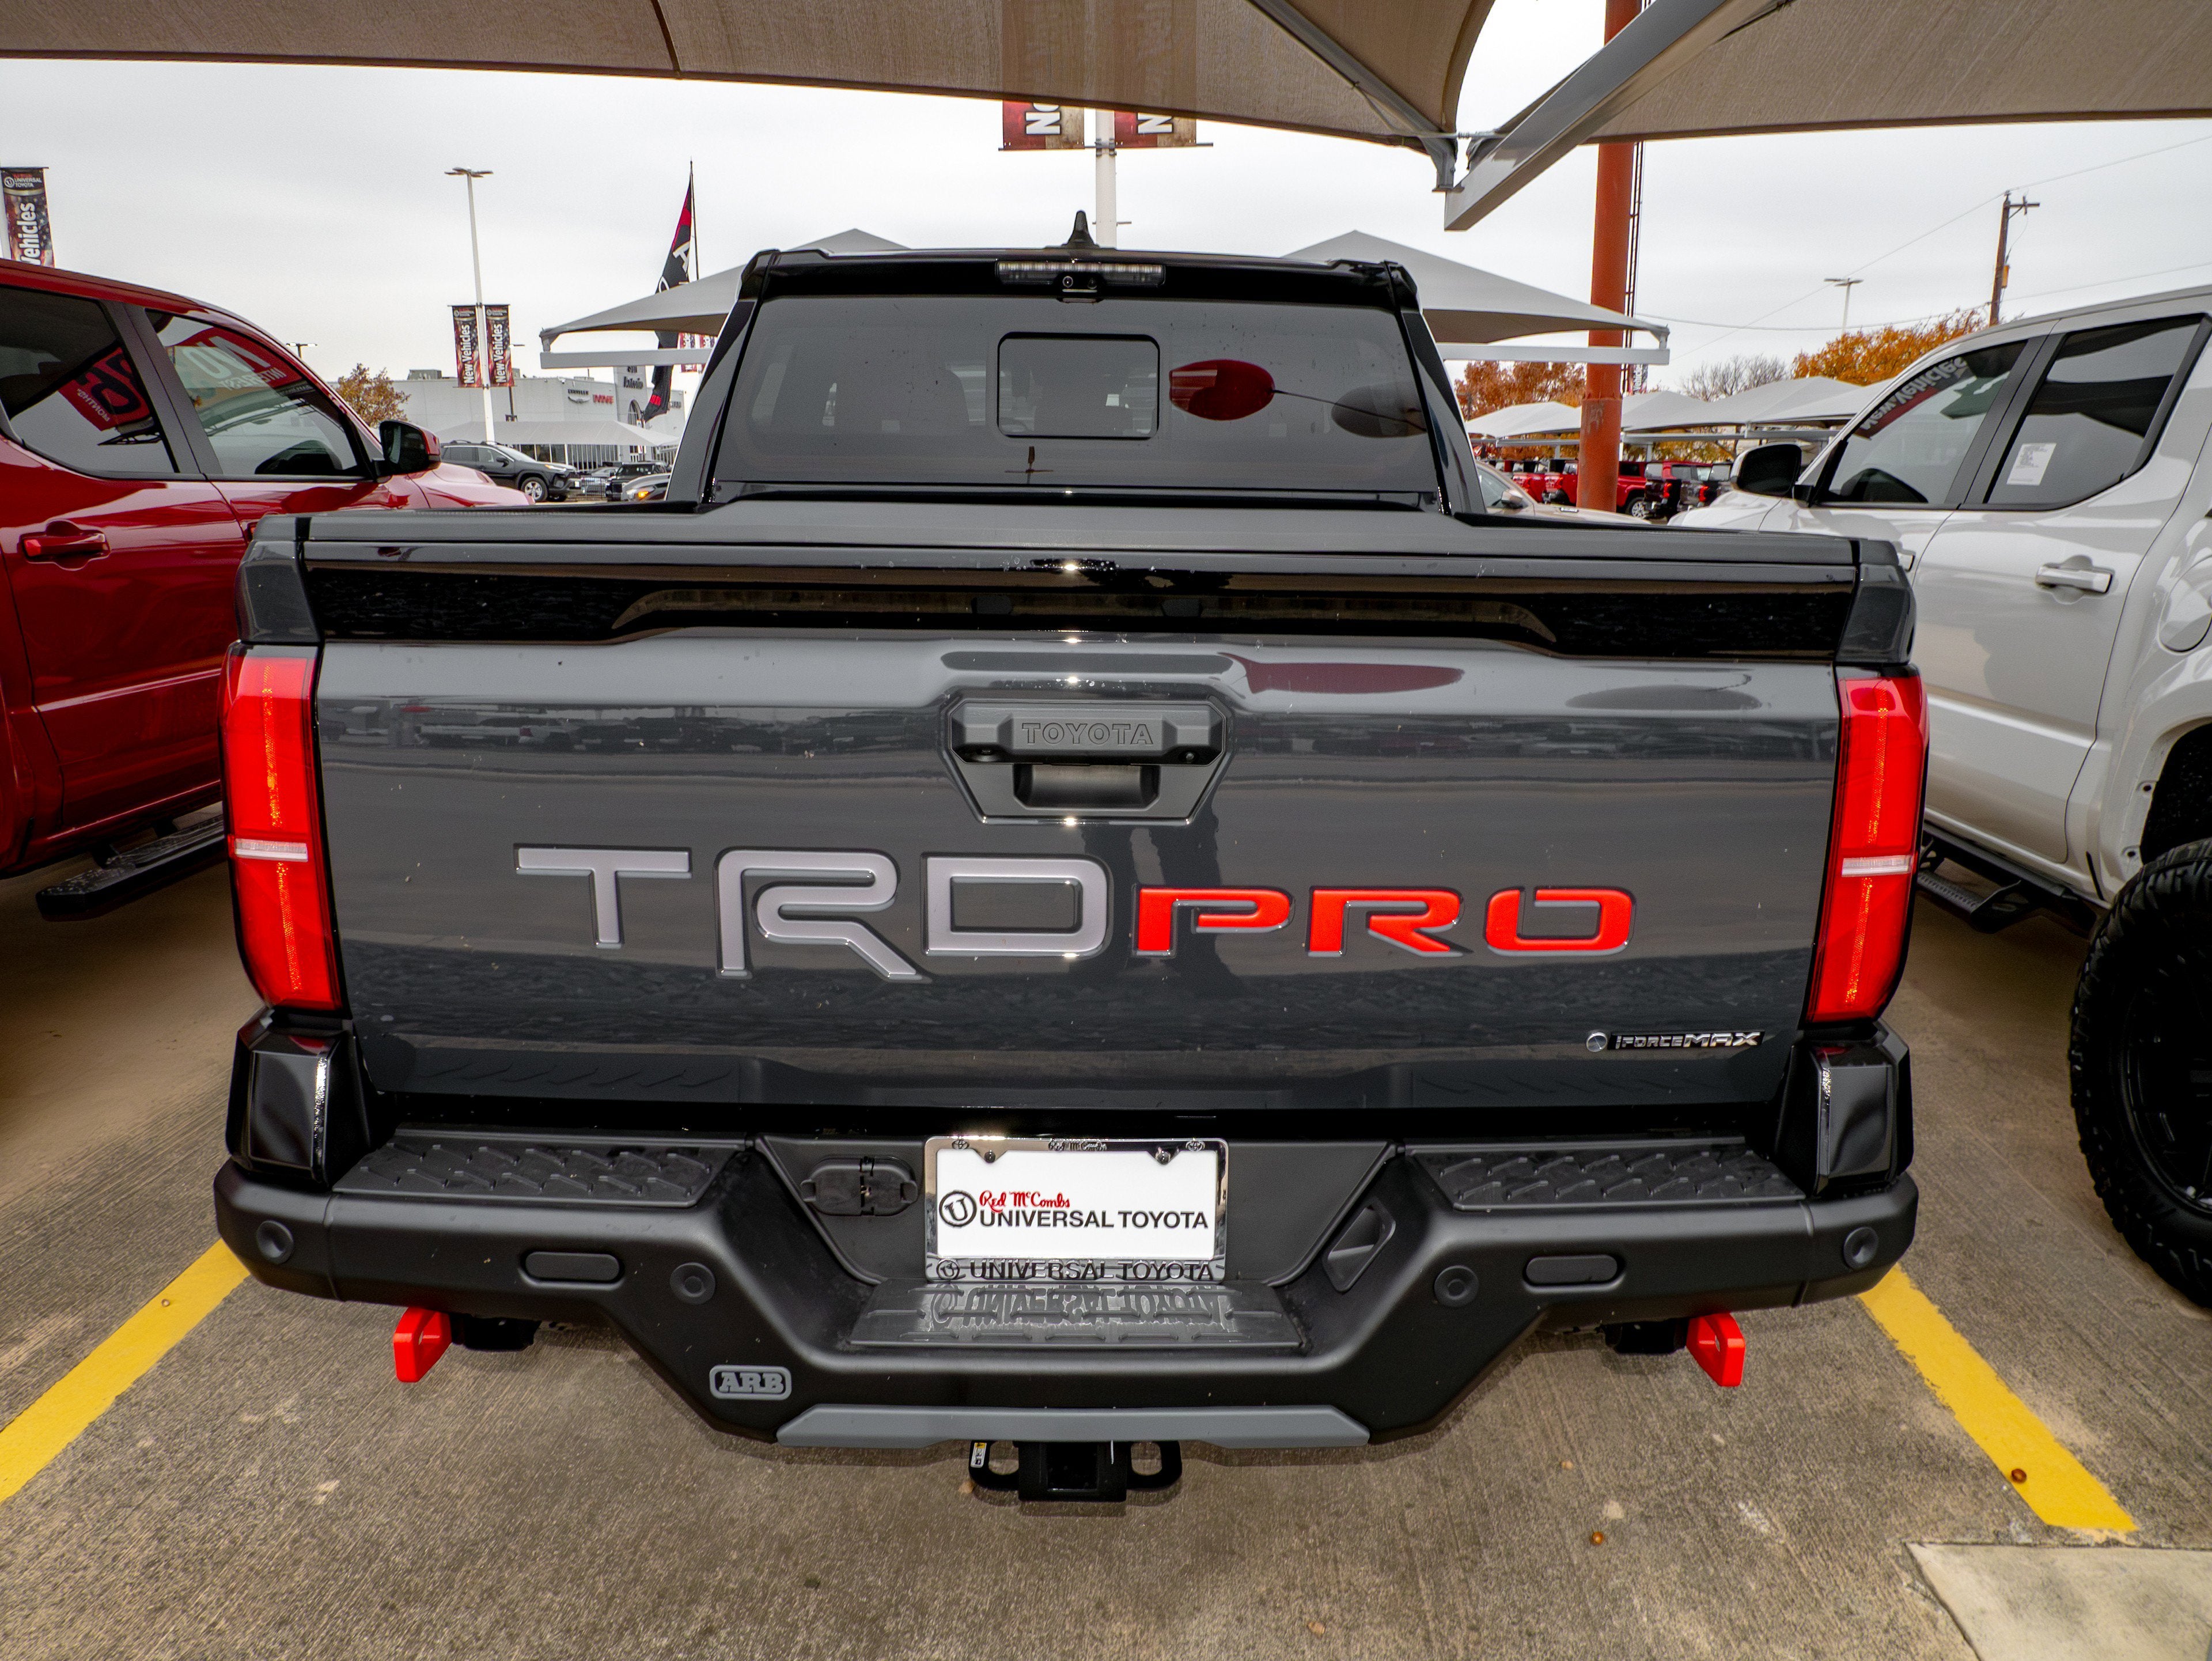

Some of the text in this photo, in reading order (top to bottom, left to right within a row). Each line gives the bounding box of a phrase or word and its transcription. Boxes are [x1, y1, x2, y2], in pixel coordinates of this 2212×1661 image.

[460, 324, 472, 362] Vehicles
[491, 324, 503, 362] Vehicles
[464, 364, 475, 384] New
[495, 363, 506, 383] New
[1022, 722, 1153, 746] TOYOTA
[514, 845, 1636, 981] TRD PRO
[979, 1190, 1006, 1213] Red
[980, 1209, 1113, 1228] UNIVERSAL
[1118, 1210, 1209, 1228] TOYOTA
[970, 1259, 1113, 1279] UNIVERSAL
[1118, 1259, 1214, 1280] TOYOTA
[719, 1372, 784, 1394] ARB
